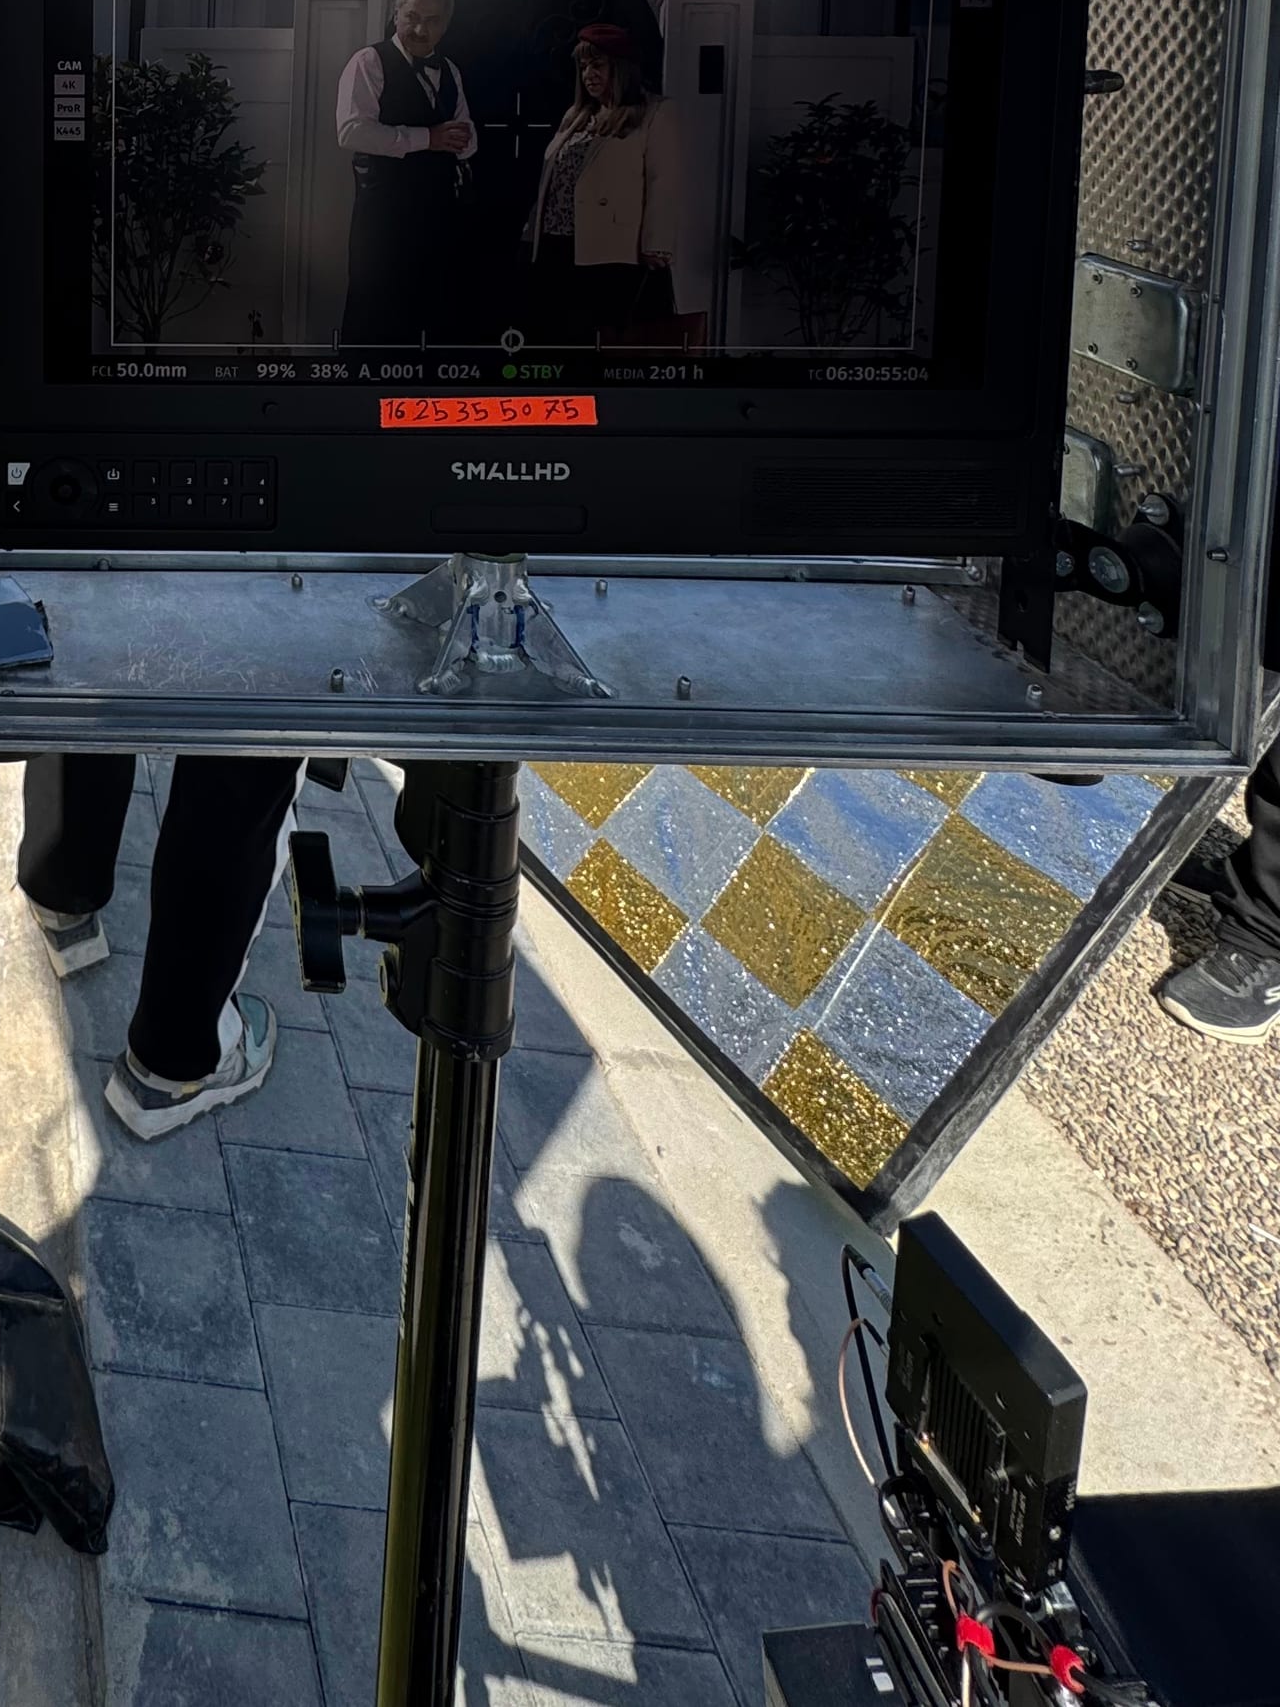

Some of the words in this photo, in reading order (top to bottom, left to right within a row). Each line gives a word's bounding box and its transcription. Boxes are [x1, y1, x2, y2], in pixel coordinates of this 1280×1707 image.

[57, 60, 82, 71] CAM
[61, 80, 76, 90] 4K
[92, 365, 112, 377] FCL
[116, 363, 187, 378] 50.0mm
[215, 366, 239, 378] BAT
[256, 363, 296, 379] 99%
[310, 363, 349, 379] 38%
[358, 364, 423, 381] A_0001
[437, 364, 481, 379] C024
[519, 364, 564, 380] STBY
[603, 367, 645, 380] MEDIA
[649, 365, 686, 380] 2:01
[693, 364, 704, 380] h
[809, 369, 823, 381] TC
[825, 366, 929, 381] 06:30:55:04
[385, 400, 406, 420] 16
[413, 399, 448, 421] 25
[455, 400, 489, 422] 35
[499, 399, 532, 422] 50
[543, 398, 579, 420] 75
[451, 461, 570, 481] SMALLHD
